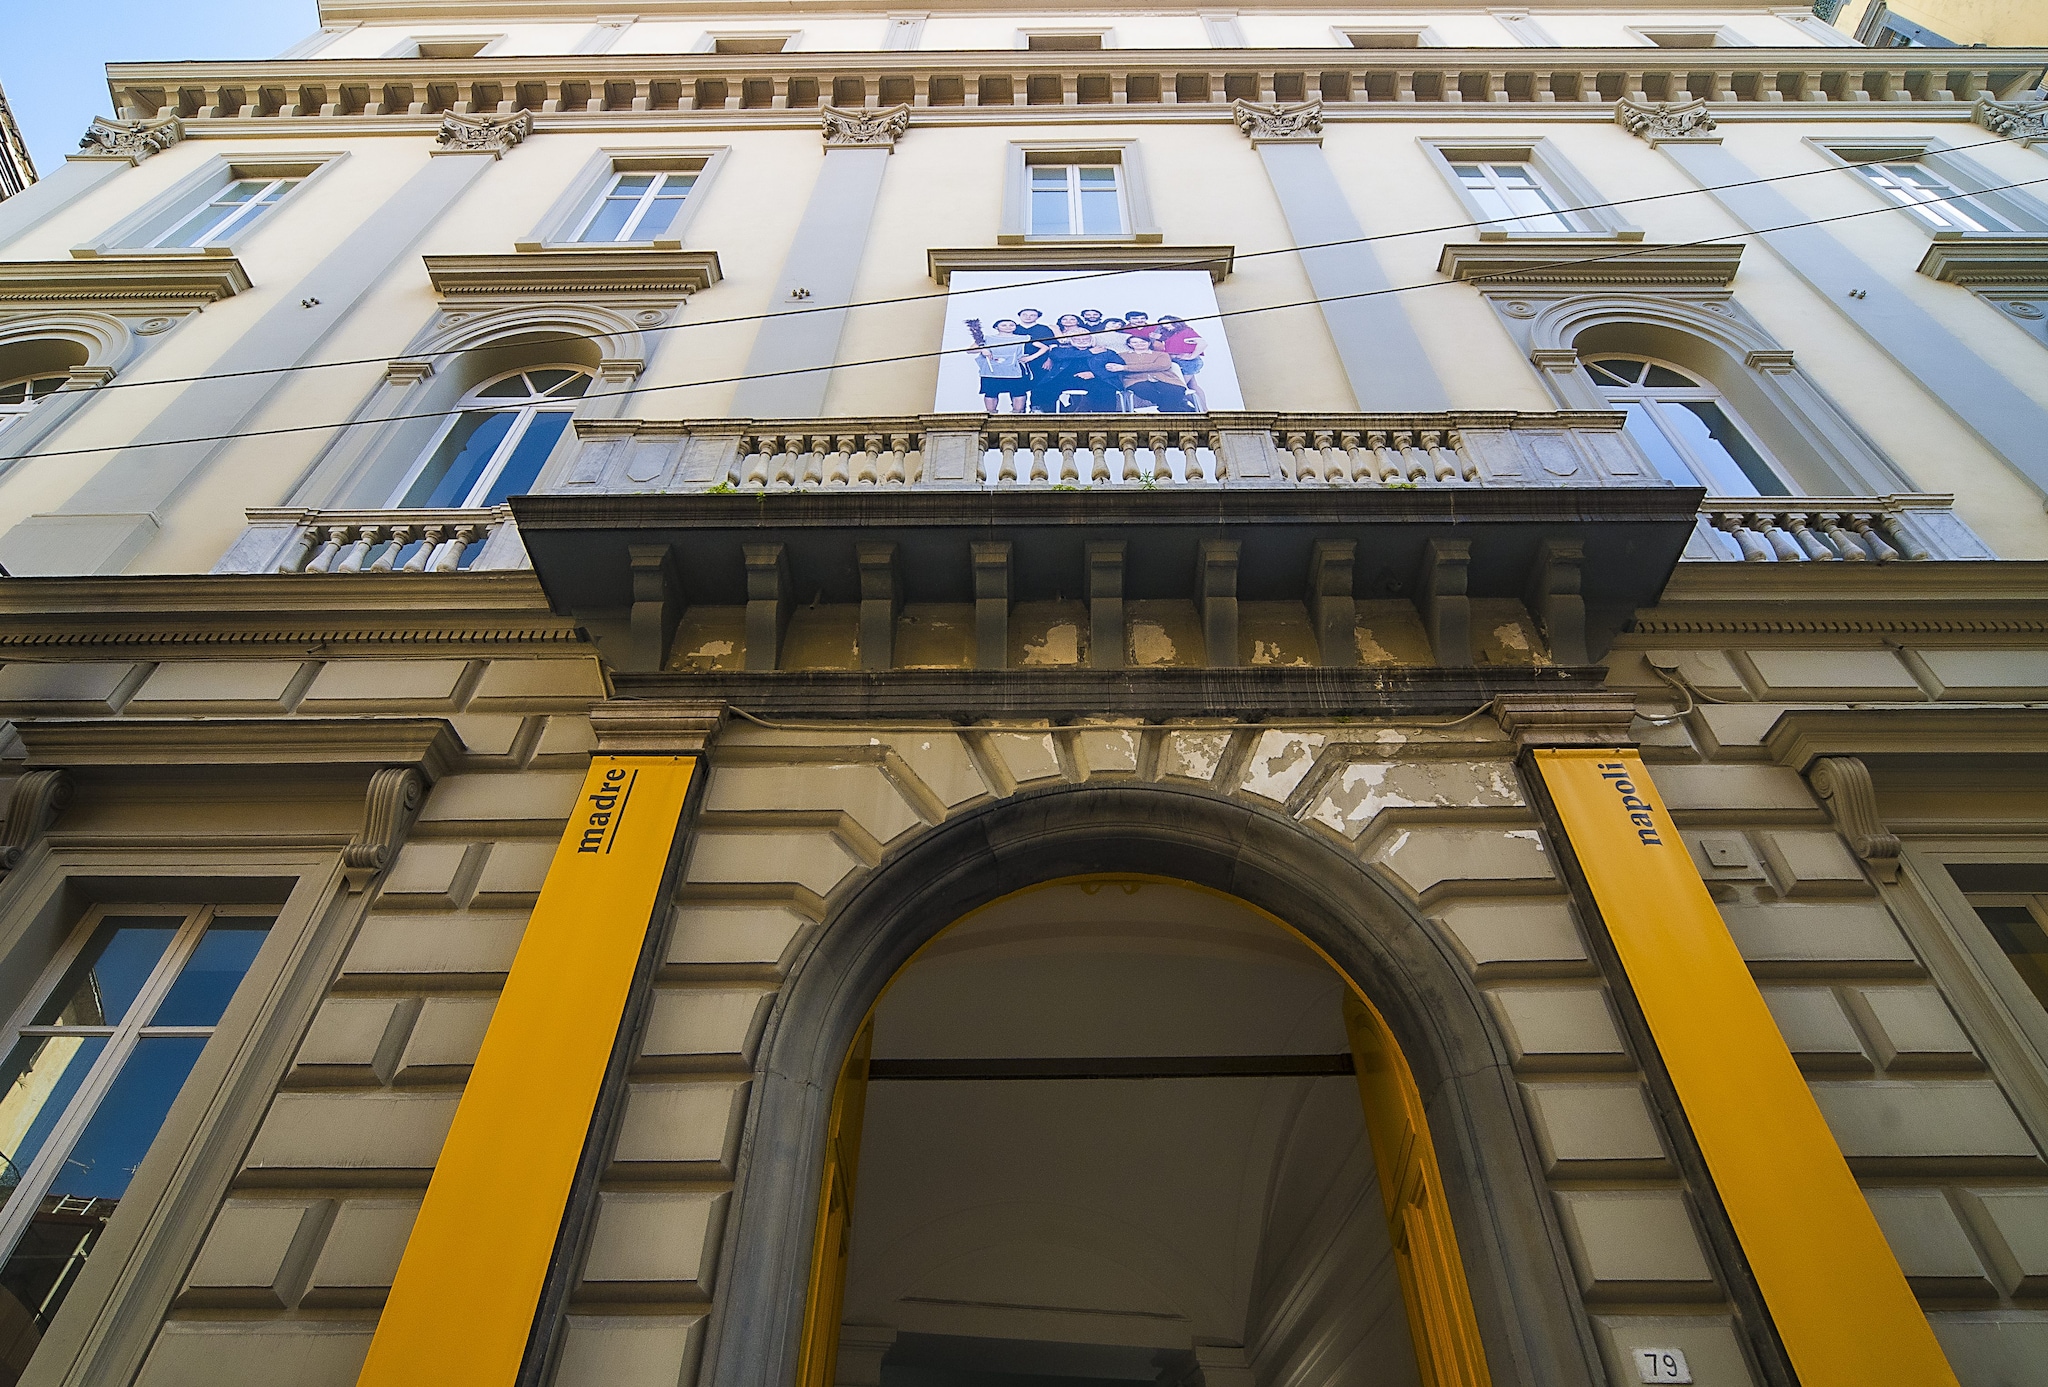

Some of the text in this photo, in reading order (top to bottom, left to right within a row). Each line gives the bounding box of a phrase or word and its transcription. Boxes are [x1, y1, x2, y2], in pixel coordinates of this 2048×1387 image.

[577, 769, 626, 853] madre
[1597, 763, 1663, 846] napoli
[1643, 1353, 1678, 1377] 79
